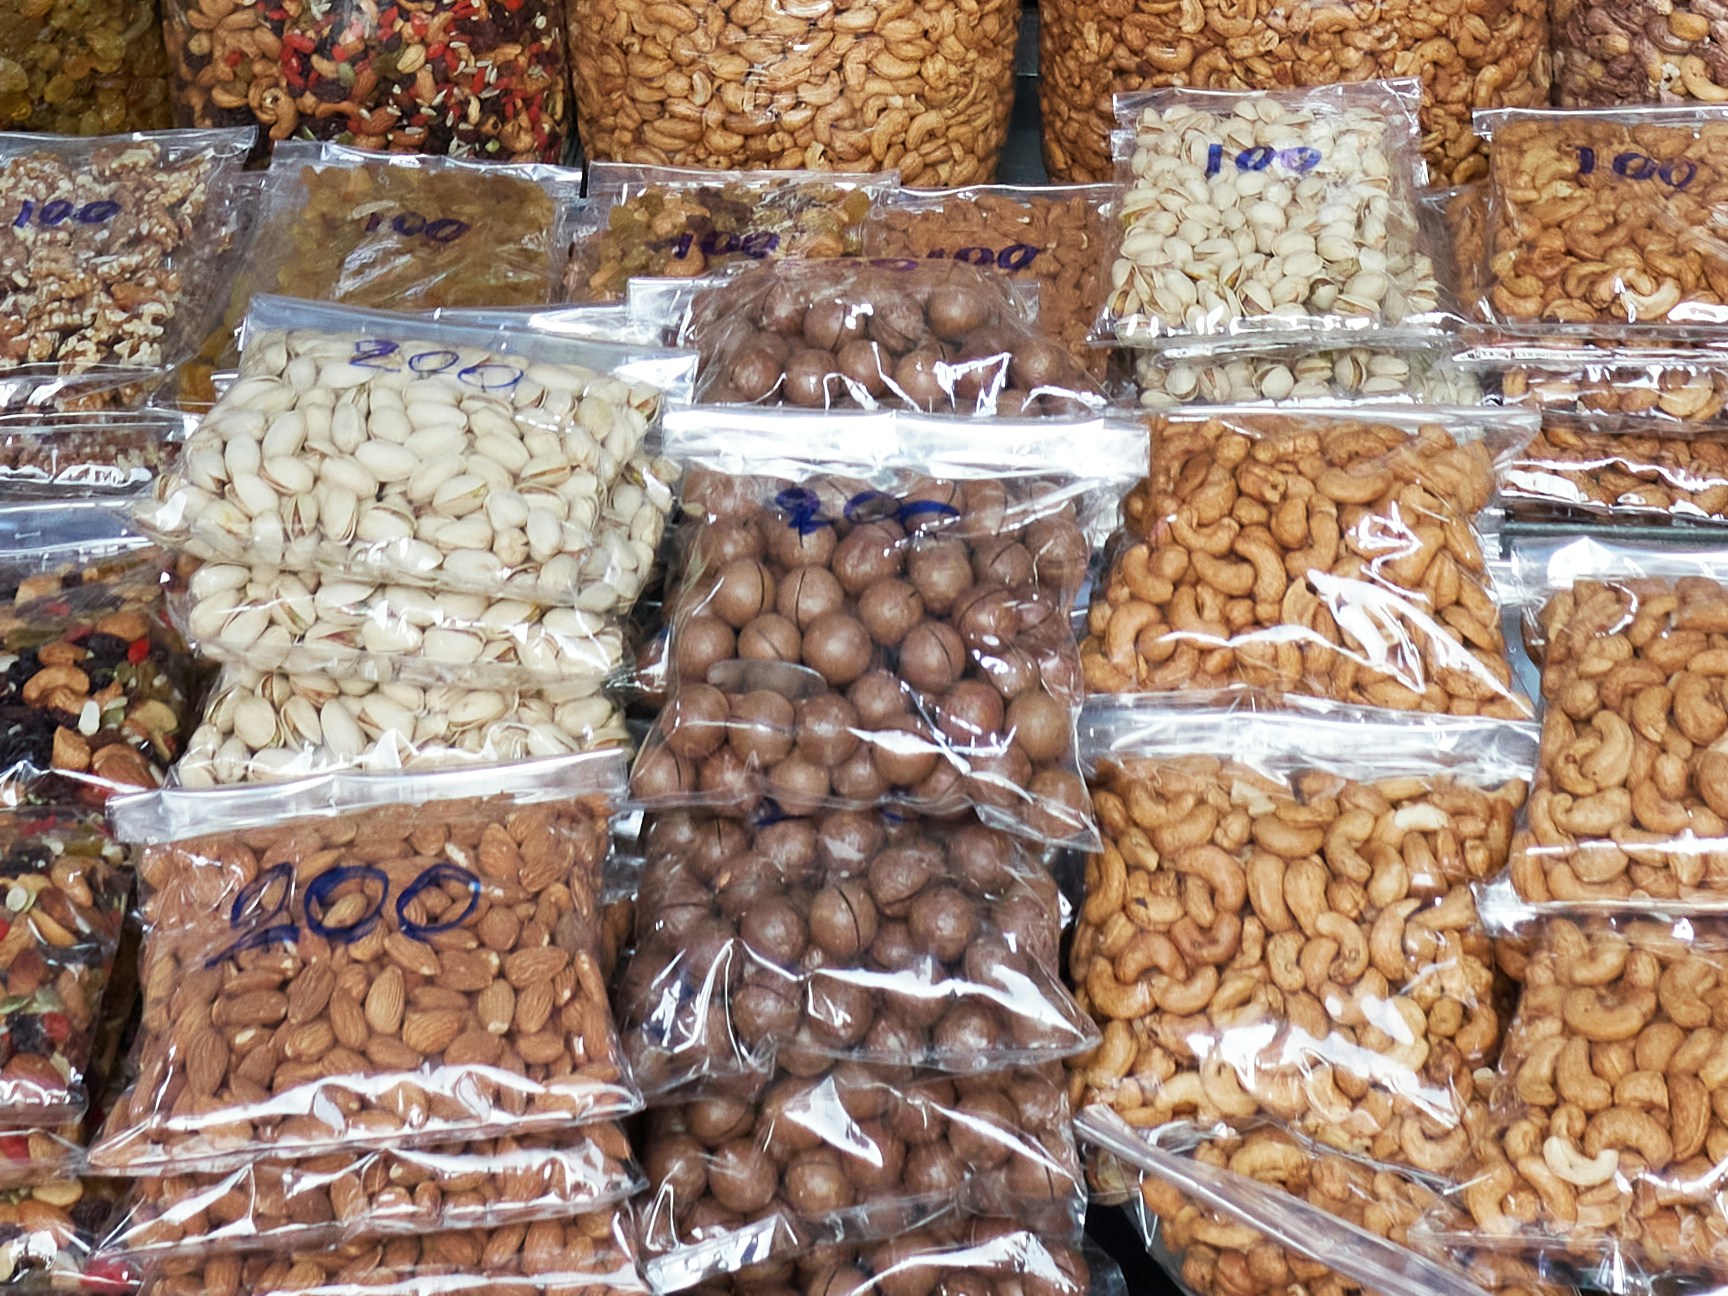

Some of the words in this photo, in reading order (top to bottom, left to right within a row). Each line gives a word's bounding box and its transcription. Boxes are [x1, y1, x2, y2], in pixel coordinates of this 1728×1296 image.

[1205, 143, 1323, 180] 100
[1576, 146, 1698, 189] 100
[13, 199, 126, 229] 100
[349, 339, 526, 393] 200
[203, 861, 483, 970] 200
